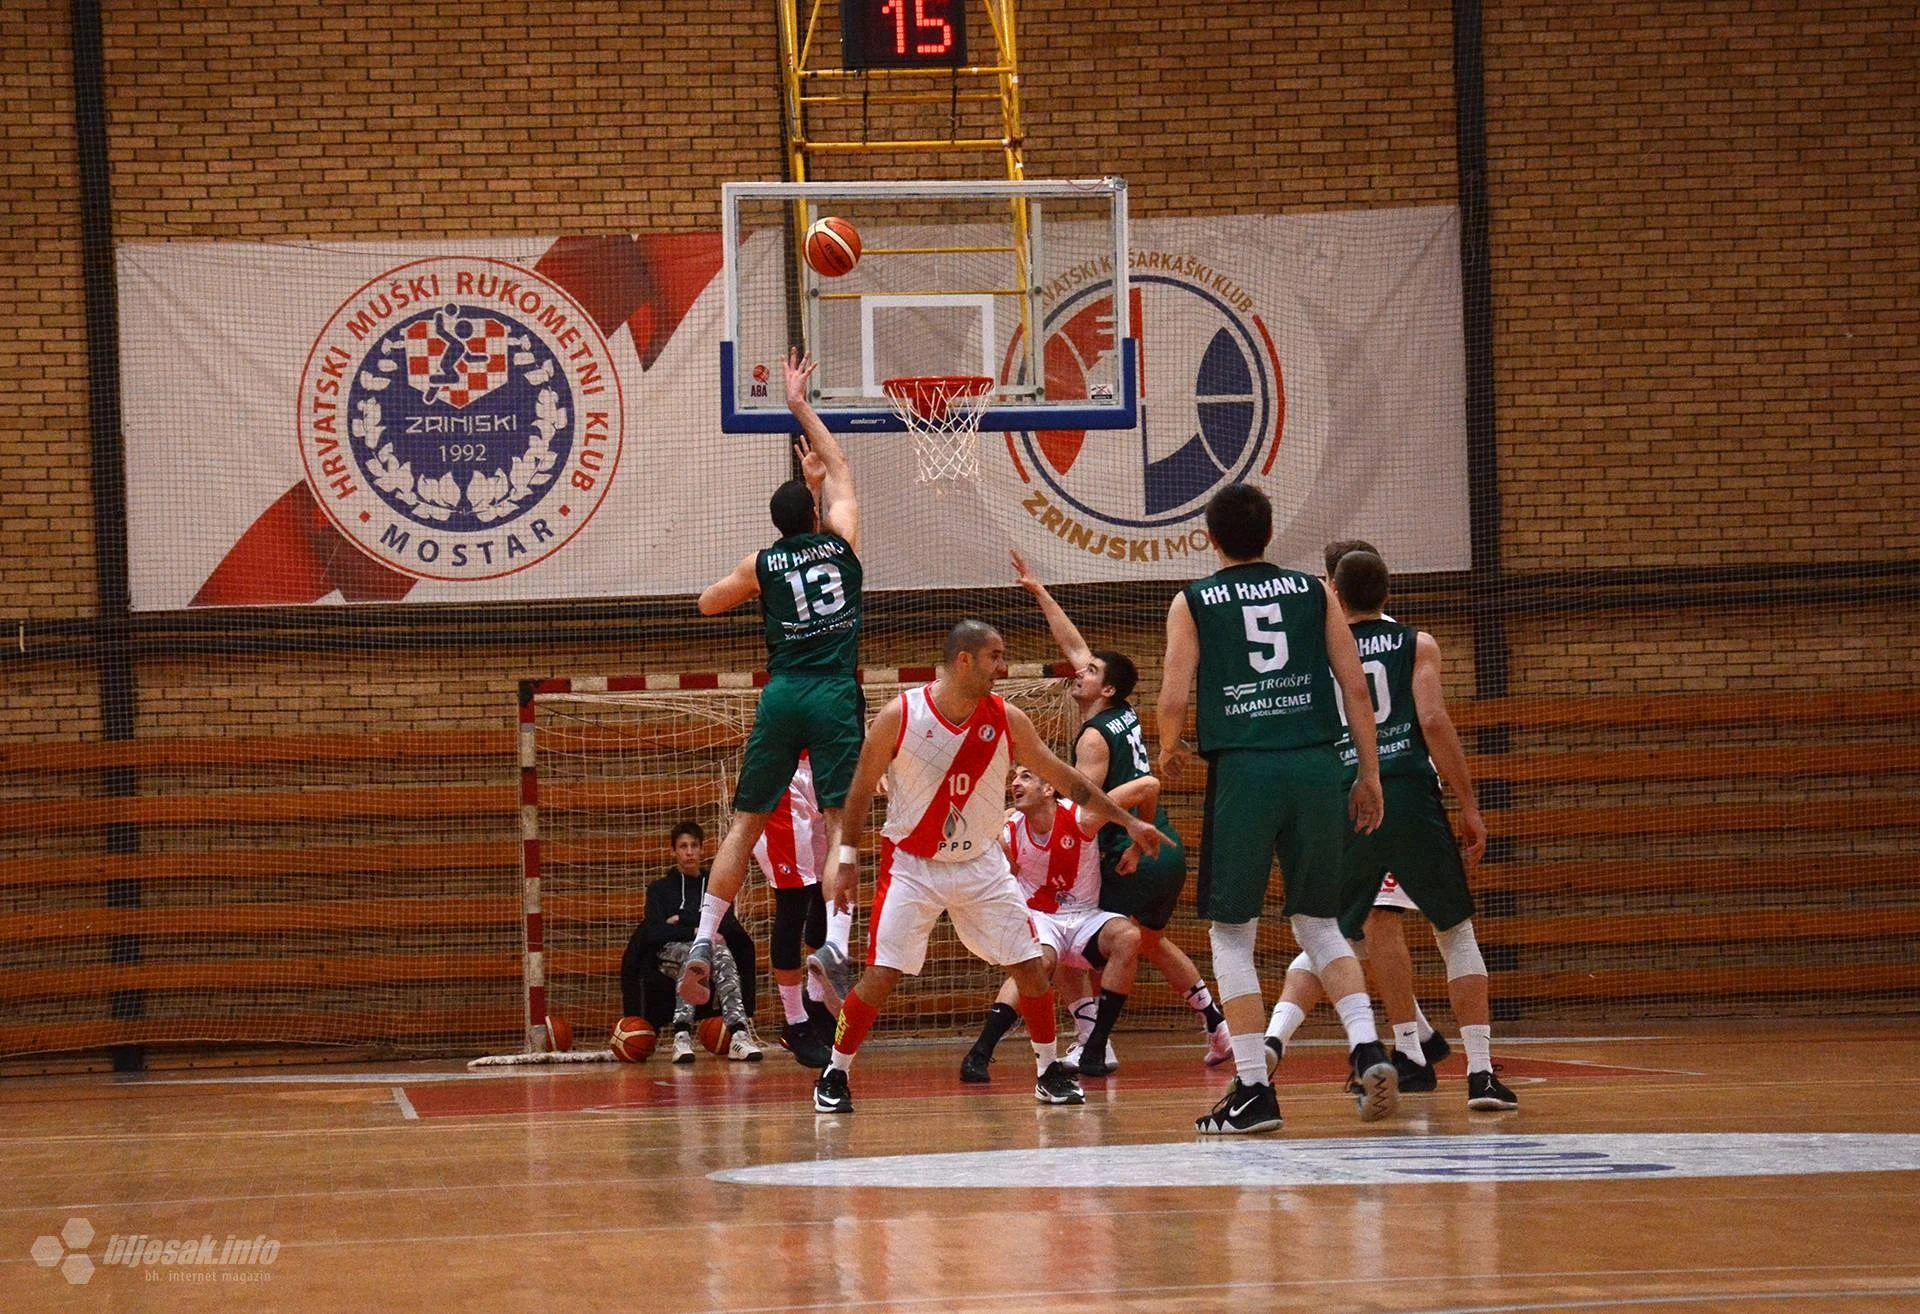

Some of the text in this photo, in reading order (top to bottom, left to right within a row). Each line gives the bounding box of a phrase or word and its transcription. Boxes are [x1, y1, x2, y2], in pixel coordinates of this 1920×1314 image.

[882, 0, 952, 54] 15
[1211, 274, 1253, 314] KLUB
[313, 271, 609, 500] HRVATSKI MUŠKI RUKOMETNI KLUB
[439, 444, 488, 463] 1992
[380, 518, 555, 567] MOSTAR
[1021, 489, 1160, 563] ZRINJSKI
[784, 562, 846, 621] 13
[1241, 602, 1289, 674] 5
[1224, 697, 1272, 716] KAKANJ
[1259, 673, 1312, 691] TRGOŠPE
[948, 773, 970, 797] 10
